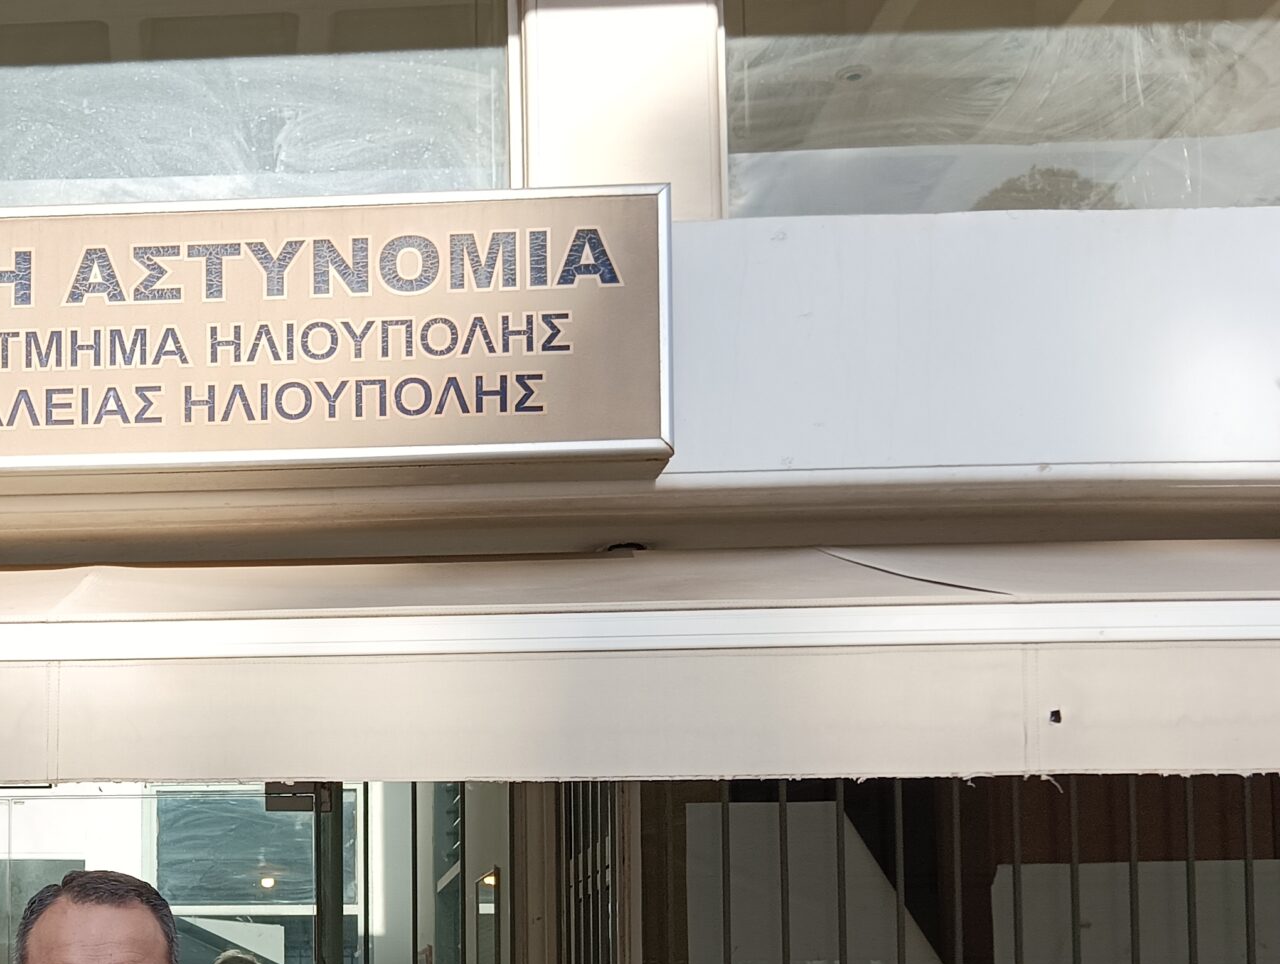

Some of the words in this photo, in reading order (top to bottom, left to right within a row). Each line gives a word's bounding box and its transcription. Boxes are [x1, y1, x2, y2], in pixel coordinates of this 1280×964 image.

[65, 227, 621, 303] ΑΣΤΥΝΟΜΙΑ
[209, 312, 571, 364] ΗΛΙΟΥΠΟΛΗΣ
[184, 373, 544, 423] ΗΛΙΟΥΠΟΛΗΣ
